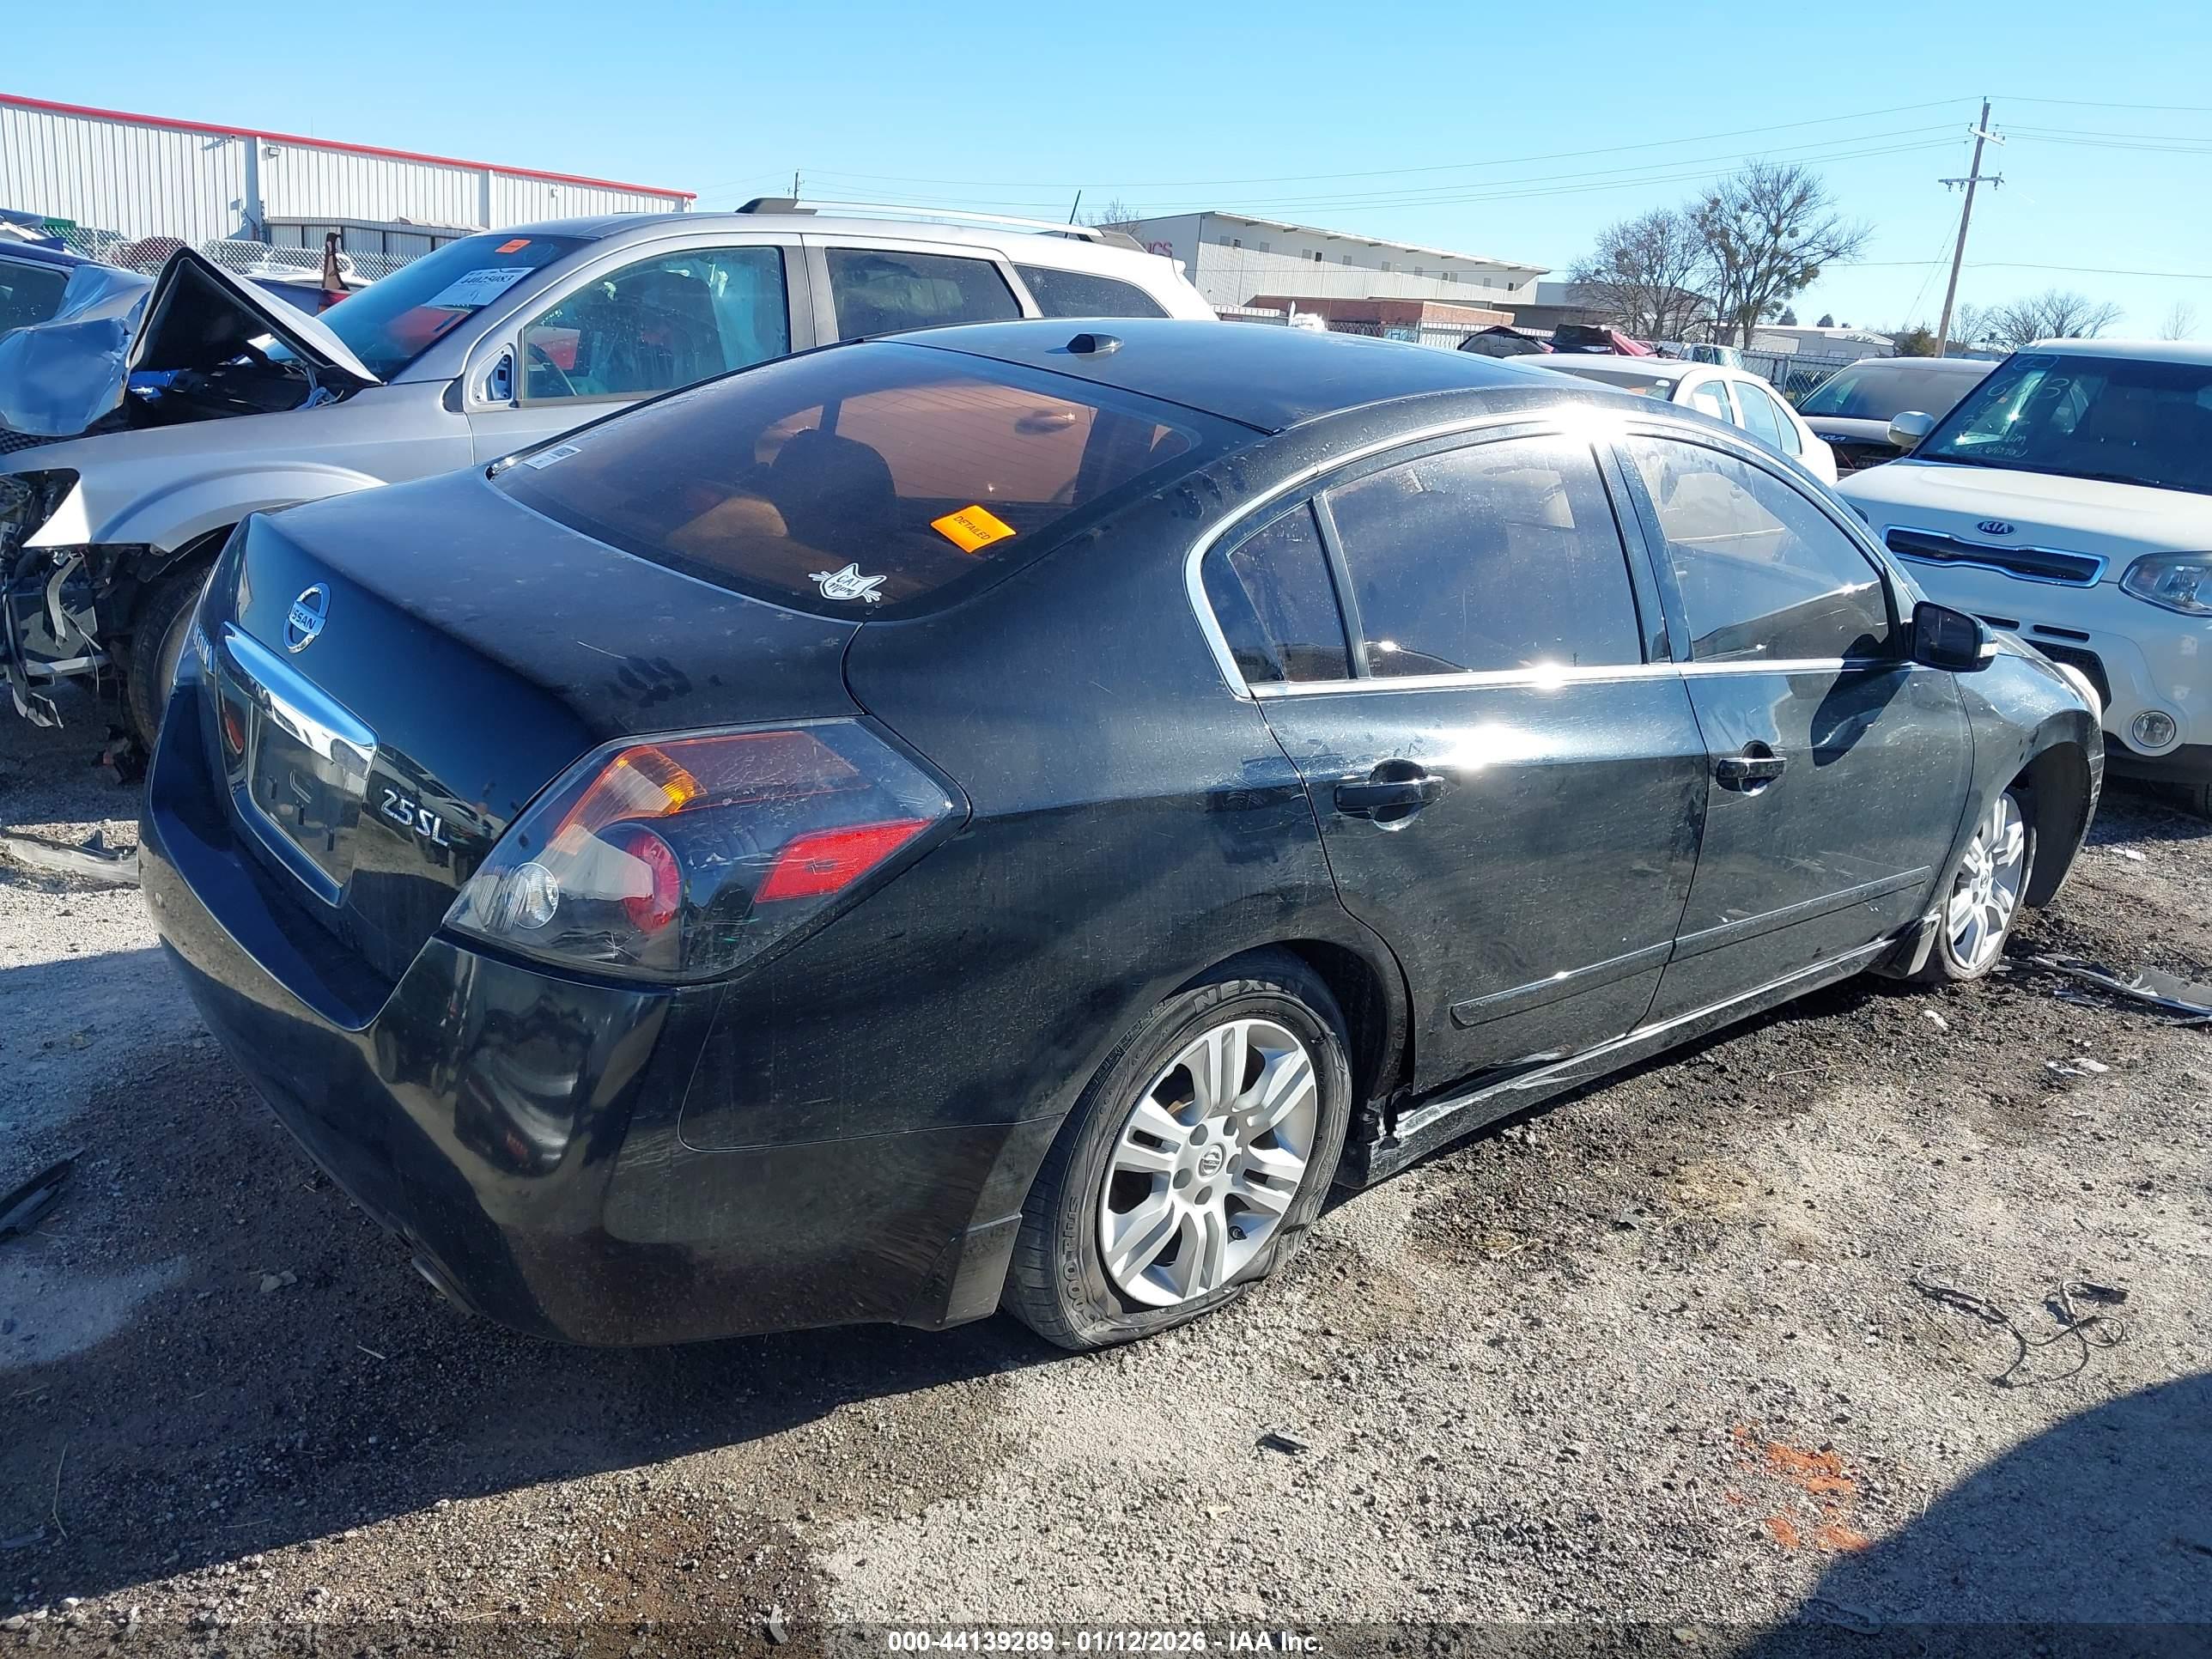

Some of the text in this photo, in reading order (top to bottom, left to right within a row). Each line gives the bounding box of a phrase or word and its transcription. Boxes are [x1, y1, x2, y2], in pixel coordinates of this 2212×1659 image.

[953, 515, 991, 540] DETAILED
[1981, 521, 2008, 533] KIA
[836, 574, 861, 587] CAT
[416, 809, 448, 848] SL
